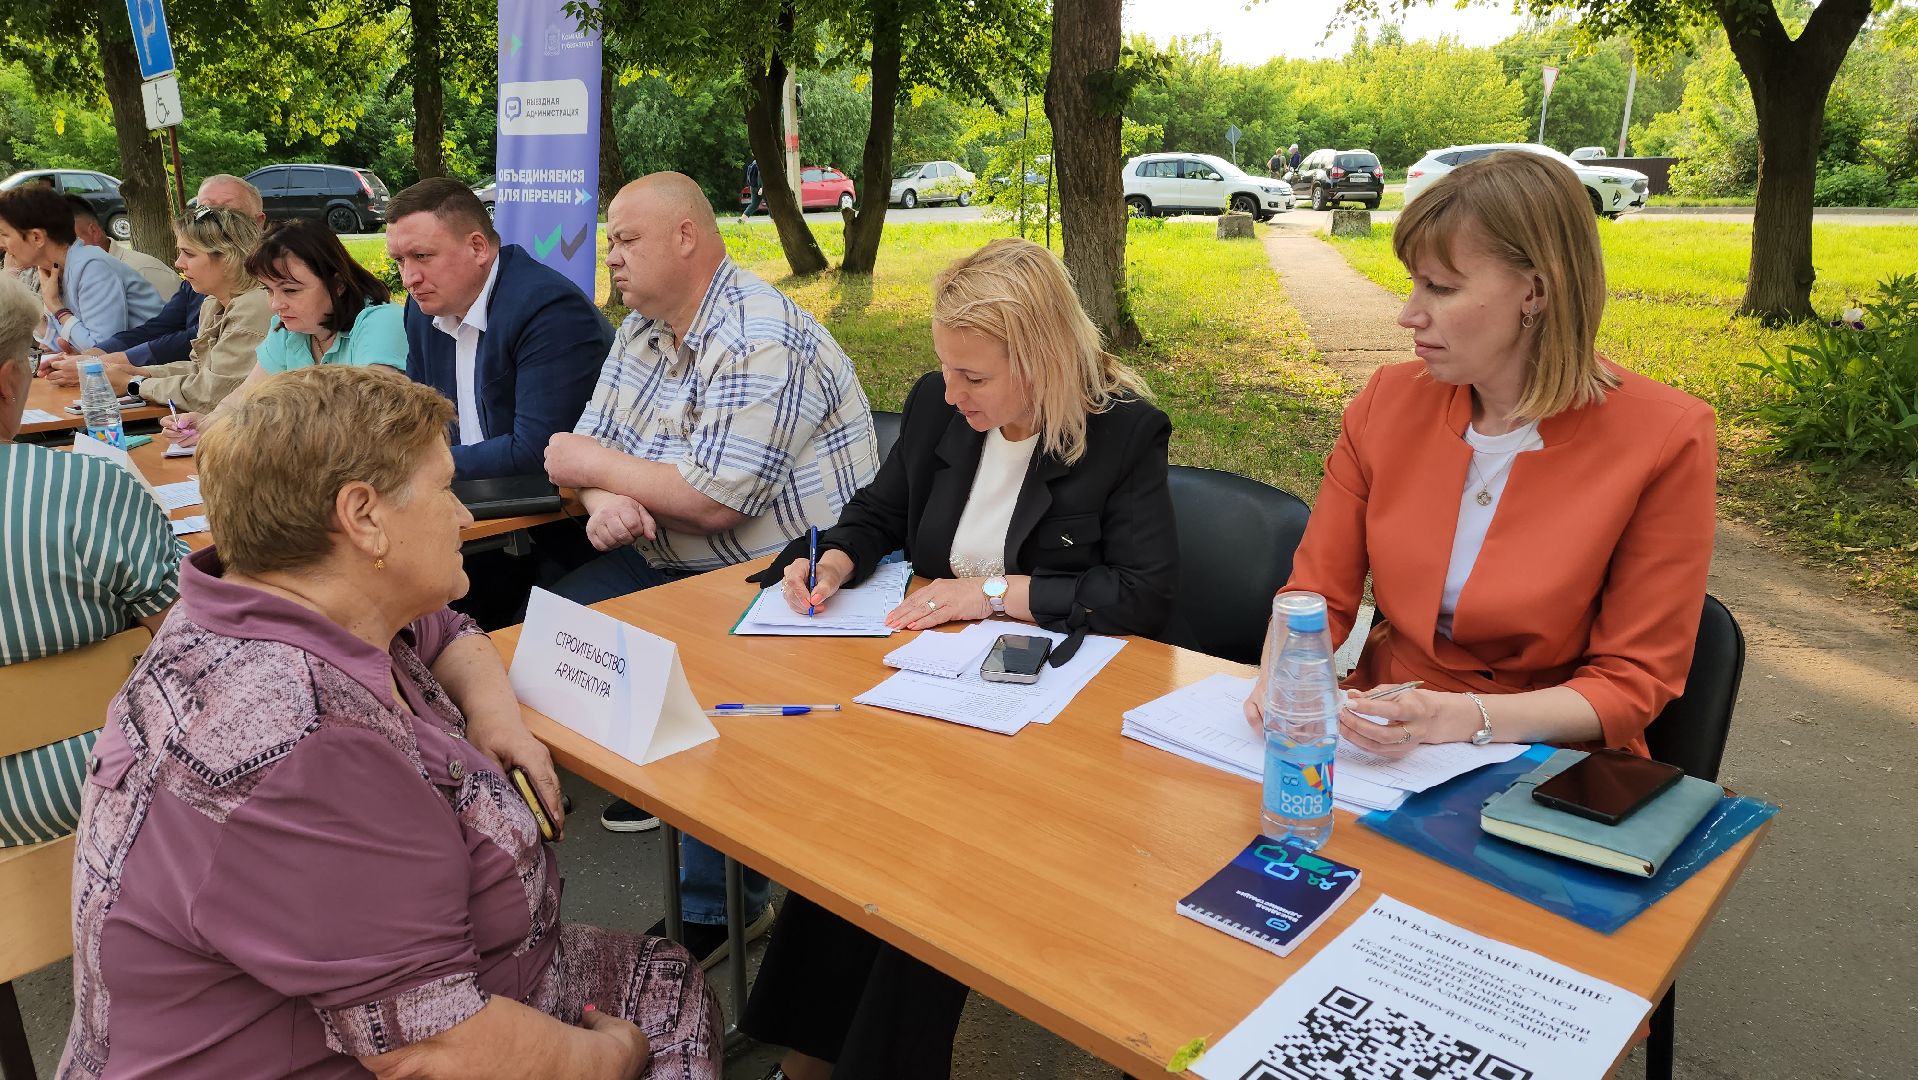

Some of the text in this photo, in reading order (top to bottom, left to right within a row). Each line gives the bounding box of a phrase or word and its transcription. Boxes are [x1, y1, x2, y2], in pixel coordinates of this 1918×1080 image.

[526, 97, 560, 107] ВЫЕЗДНАЯ
[526, 108, 579, 119] АДМИНИСТРАЦИЯ
[497, 187, 572, 204] ДЛЯ ПЕРЕМЕН
[498, 168, 585, 185] ОБЪЕДИНЯЕМСЯ
[555, 631, 627, 679] СТРОИТЕЛЬСТВО,
[554, 661, 612, 699] АРХИТЕКТУРА
[1373, 907, 1613, 1005] НАМ ВАЖНО ВАШЕ МНЕНИЕ!
[1390, 935, 1578, 1012] ЕСЛИ ВАШ ВОПРОС ОСТАЛСЯ
[1352, 943, 1430, 979] ПОЖЕЛАНИЯ
[1518, 1012, 1588, 1044] ФОРМАТЕ
[1359, 937, 1591, 1036] ЕСЛИ ВЫ ХОТИТЕ НАПРАВИТЬ СВОИ
[1367, 976, 1528, 1050] ОТСКАНИРУЙТЕ QR-КОД
